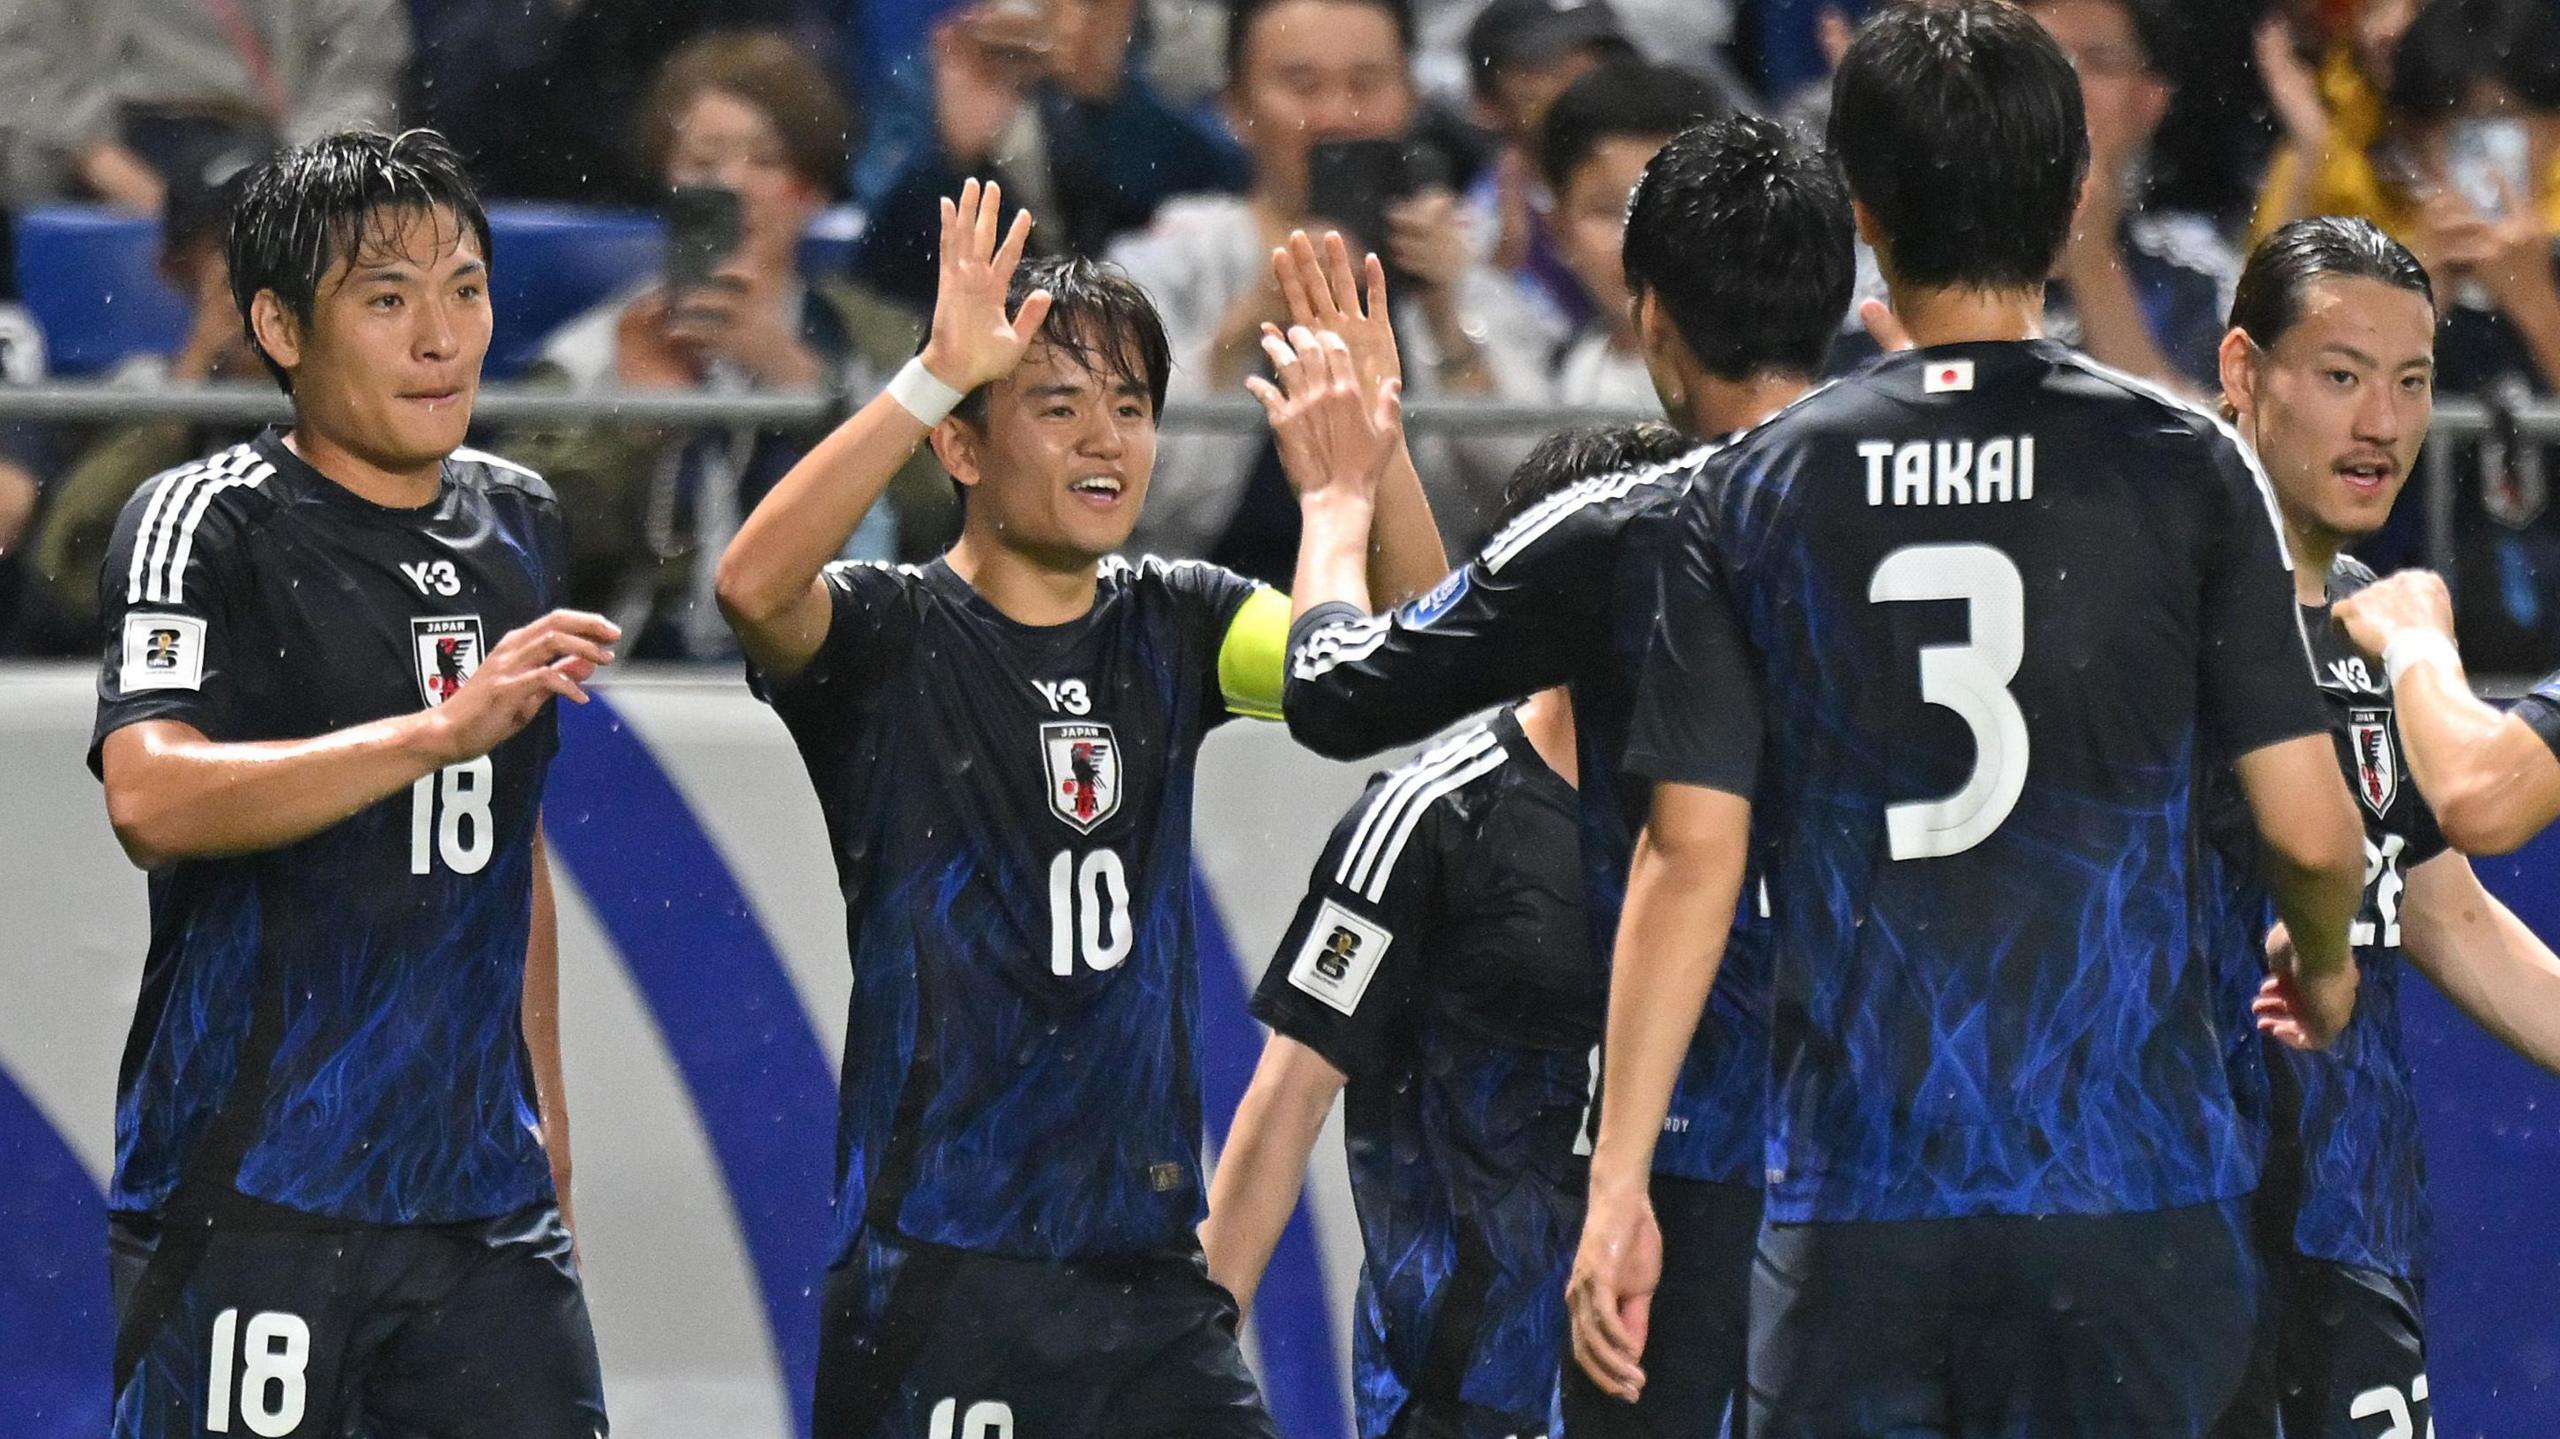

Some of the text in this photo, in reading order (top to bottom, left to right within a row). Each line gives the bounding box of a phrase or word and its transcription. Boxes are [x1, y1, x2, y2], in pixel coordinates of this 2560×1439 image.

[1858, 435, 2035, 506] TAKAI
[399, 560, 461, 597] Y-3
[427, 621, 465, 633] JAPAN
[1031, 678, 1091, 716] Y-3
[2328, 657, 2371, 693] Y-3
[1869, 543, 2030, 862] 3
[1061, 727, 1099, 738] JAPAN
[411, 754, 494, 875] 18
[1050, 849, 1133, 976] 10
[207, 1307, 310, 1438] 18
